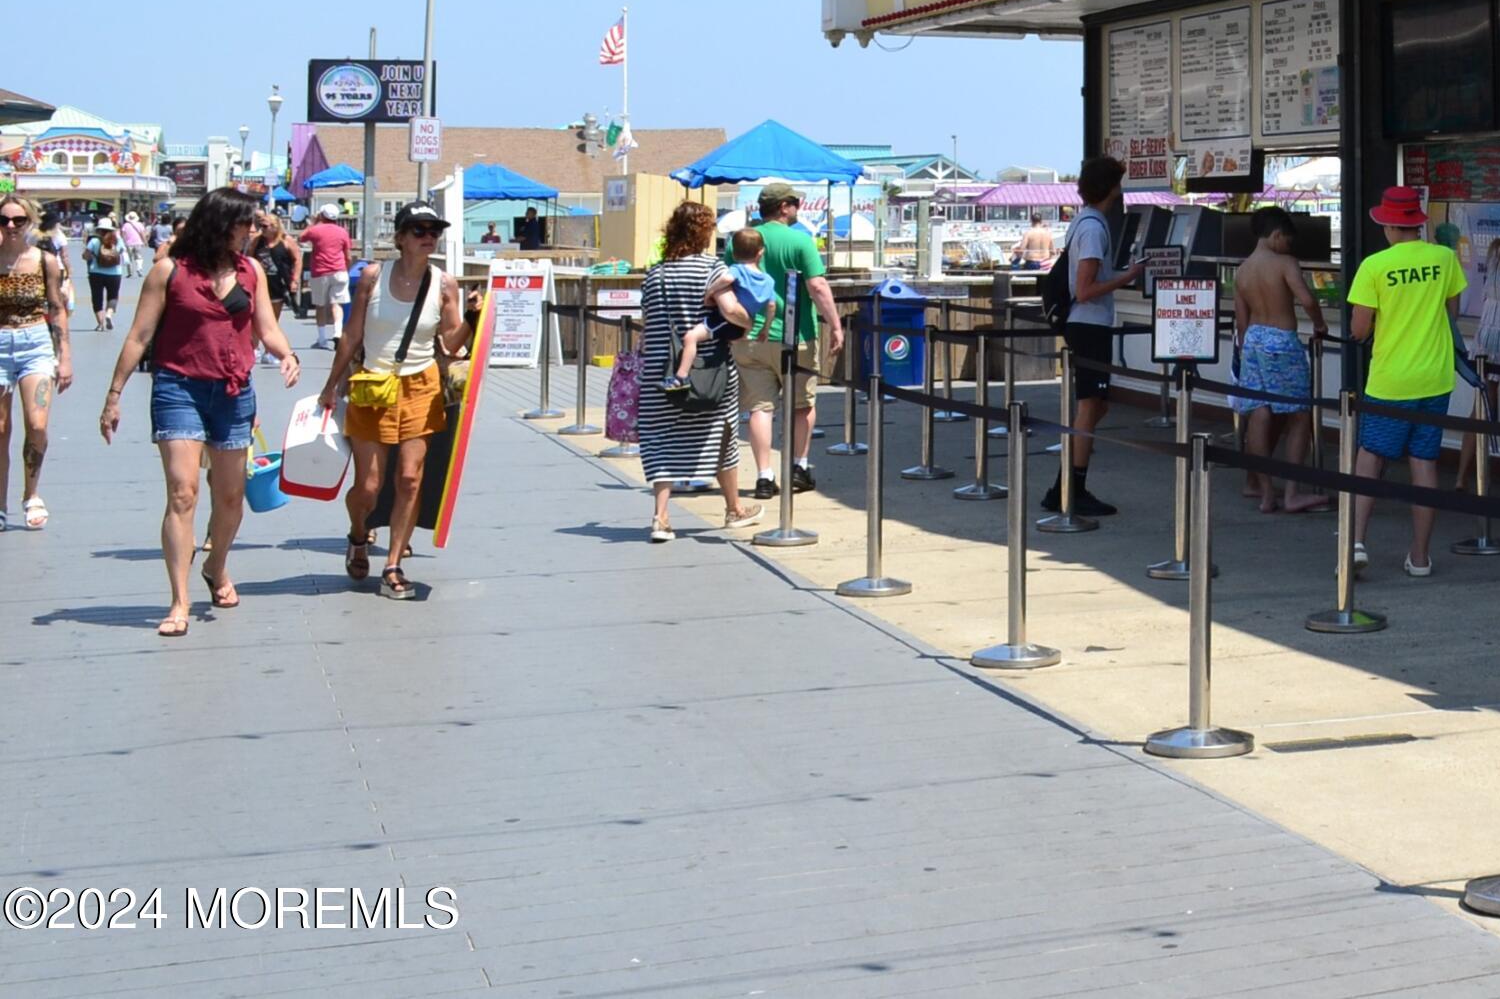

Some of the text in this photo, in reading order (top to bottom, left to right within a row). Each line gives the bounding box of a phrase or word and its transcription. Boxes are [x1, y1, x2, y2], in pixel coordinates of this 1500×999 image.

[381, 65, 424, 81] JOIN U
[389, 83, 422, 99] NEXT
[420, 124, 434, 134] NO
[415, 136, 438, 146] DOGS
[1387, 265, 1440, 287] STAFF
[504, 277, 530, 289] NO
[1183, 279, 1203, 290] WAIT
[1176, 294, 1196, 305] LINE!
[1157, 308, 1214, 319] ORDER ONLINE!
